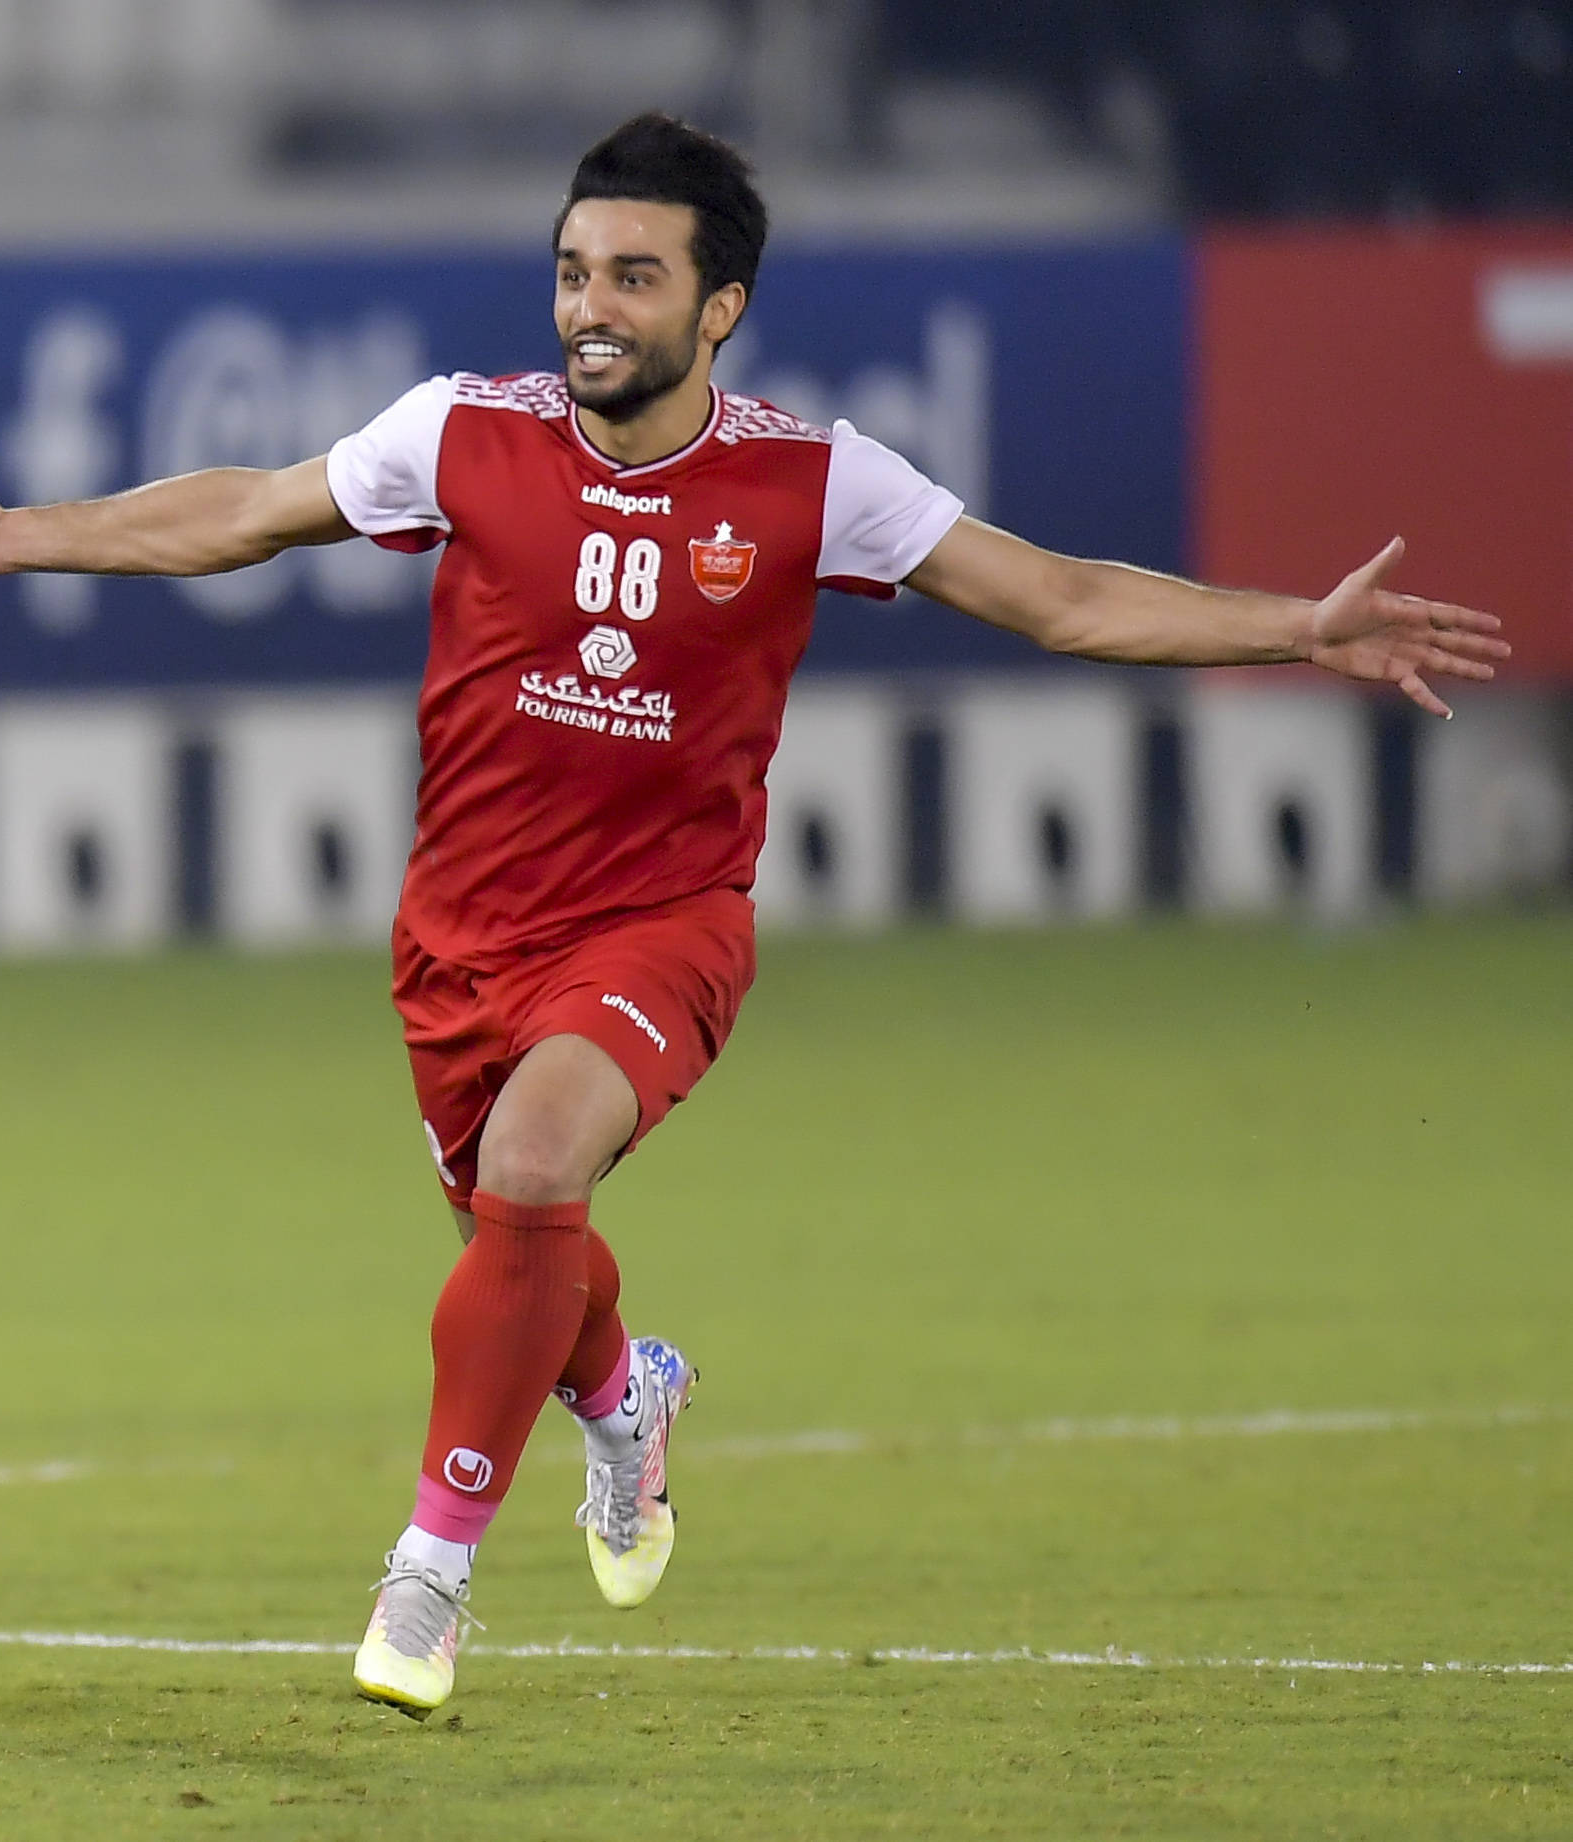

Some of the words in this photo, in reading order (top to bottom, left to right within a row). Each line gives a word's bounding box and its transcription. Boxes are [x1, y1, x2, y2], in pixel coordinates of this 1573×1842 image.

[580, 483, 673, 516] uhlsport
[574, 531, 662, 622] 88
[514, 691, 609, 734] TOURISM
[609, 716, 674, 742] BANK
[600, 993, 668, 1055] uhlsport
